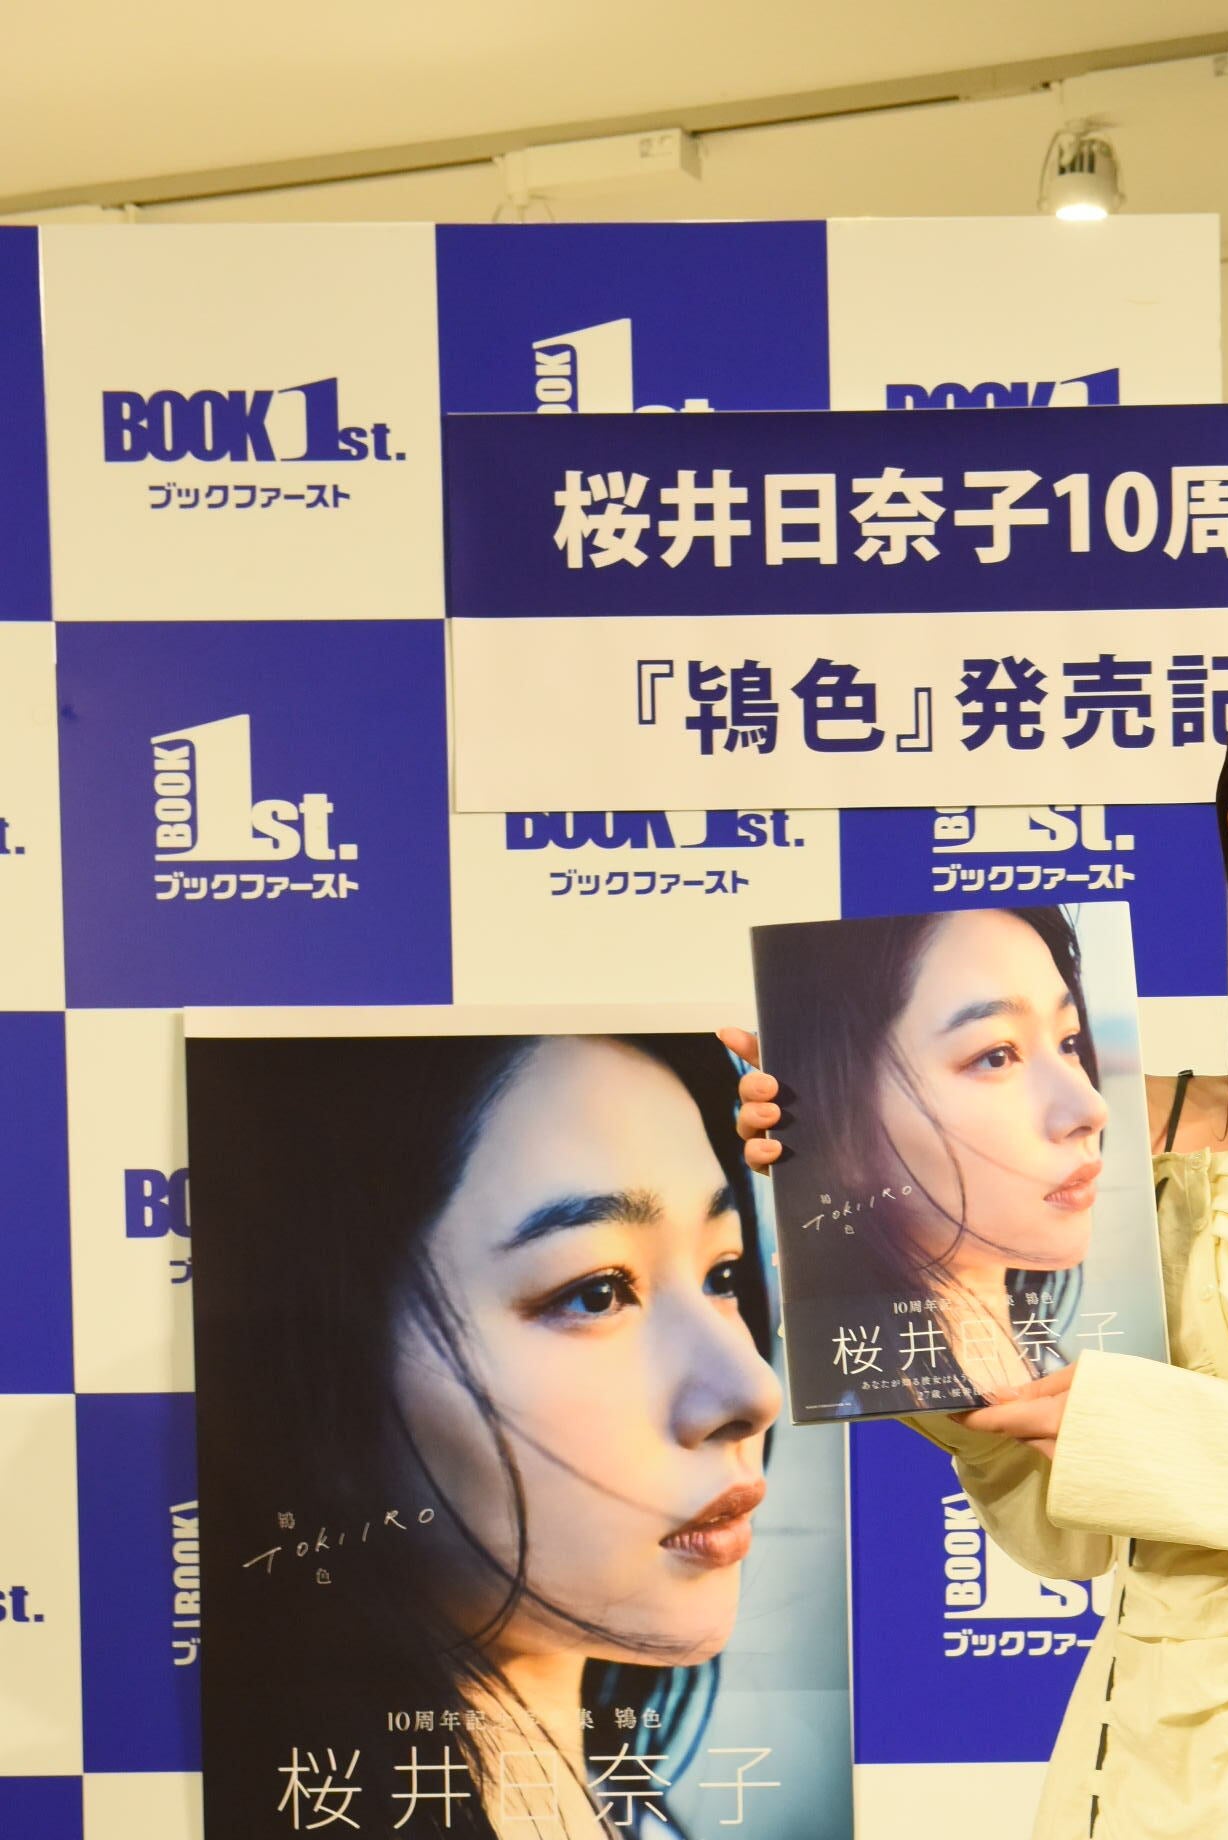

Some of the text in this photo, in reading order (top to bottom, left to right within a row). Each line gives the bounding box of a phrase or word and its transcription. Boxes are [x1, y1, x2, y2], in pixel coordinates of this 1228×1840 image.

[150, 485, 351, 511] ブックファースト
[153, 873, 359, 901] ブックファースト
[550, 870, 750, 897] ブックファースト
[932, 864, 1135, 892] ブックファースト
[831, 1311, 1125, 1376] 桜井日奈子
[943, 1628, 1096, 1657] ブックファー
[276, 1742, 782, 1831] 桜井日奈子
